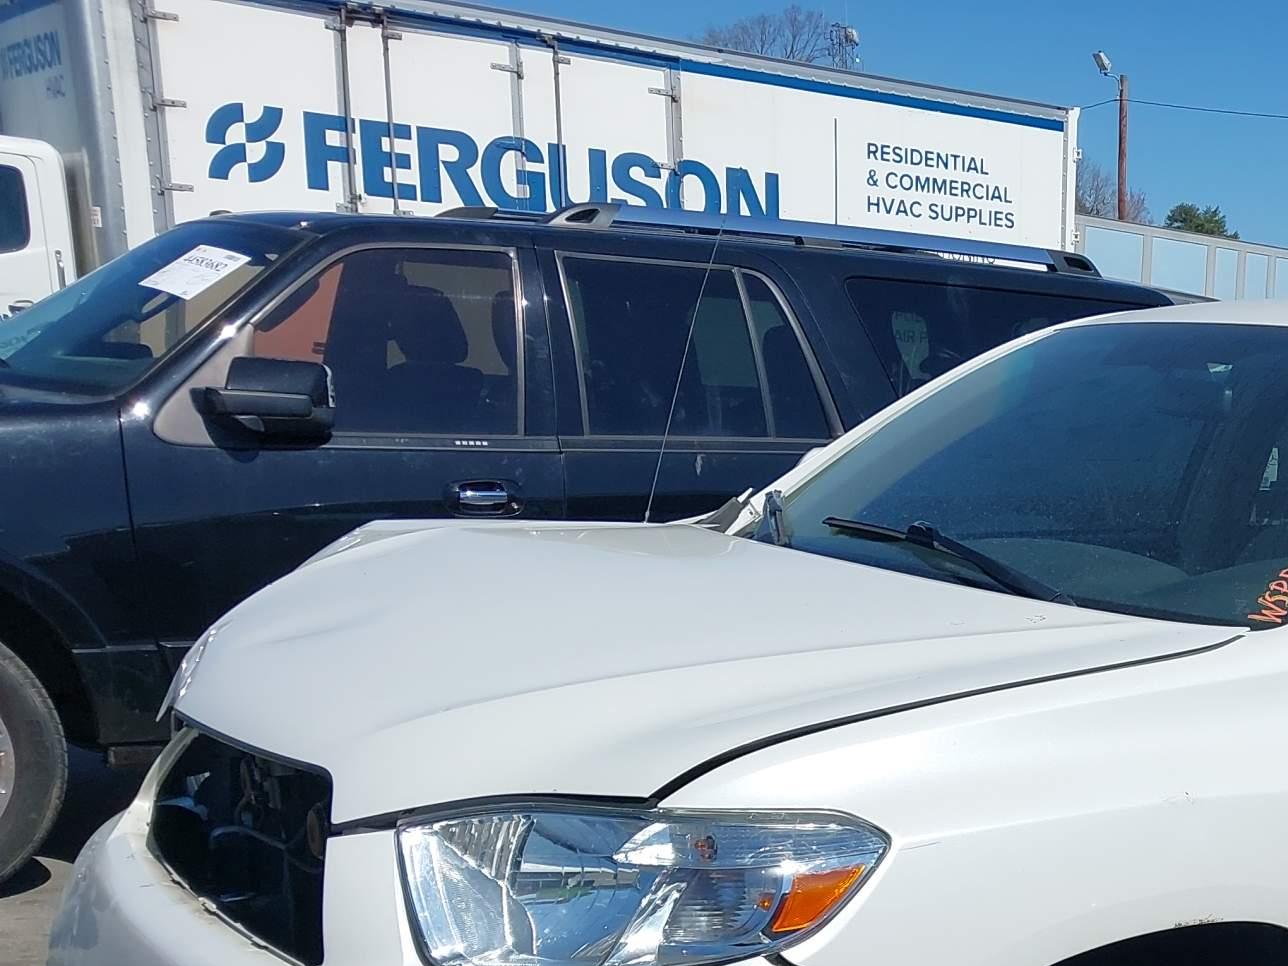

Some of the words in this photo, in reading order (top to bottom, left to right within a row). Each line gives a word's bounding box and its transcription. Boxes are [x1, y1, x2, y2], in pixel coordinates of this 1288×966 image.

[303, 110, 780, 221] FERGUSON
[866, 142, 989, 176] RESIDENTIAL
[866, 169, 879, 188] &
[885, 171, 1013, 204] COMMERCIAL
[866, 195, 922, 219] HVAC
[928, 202, 1015, 229] SUPPLIES
